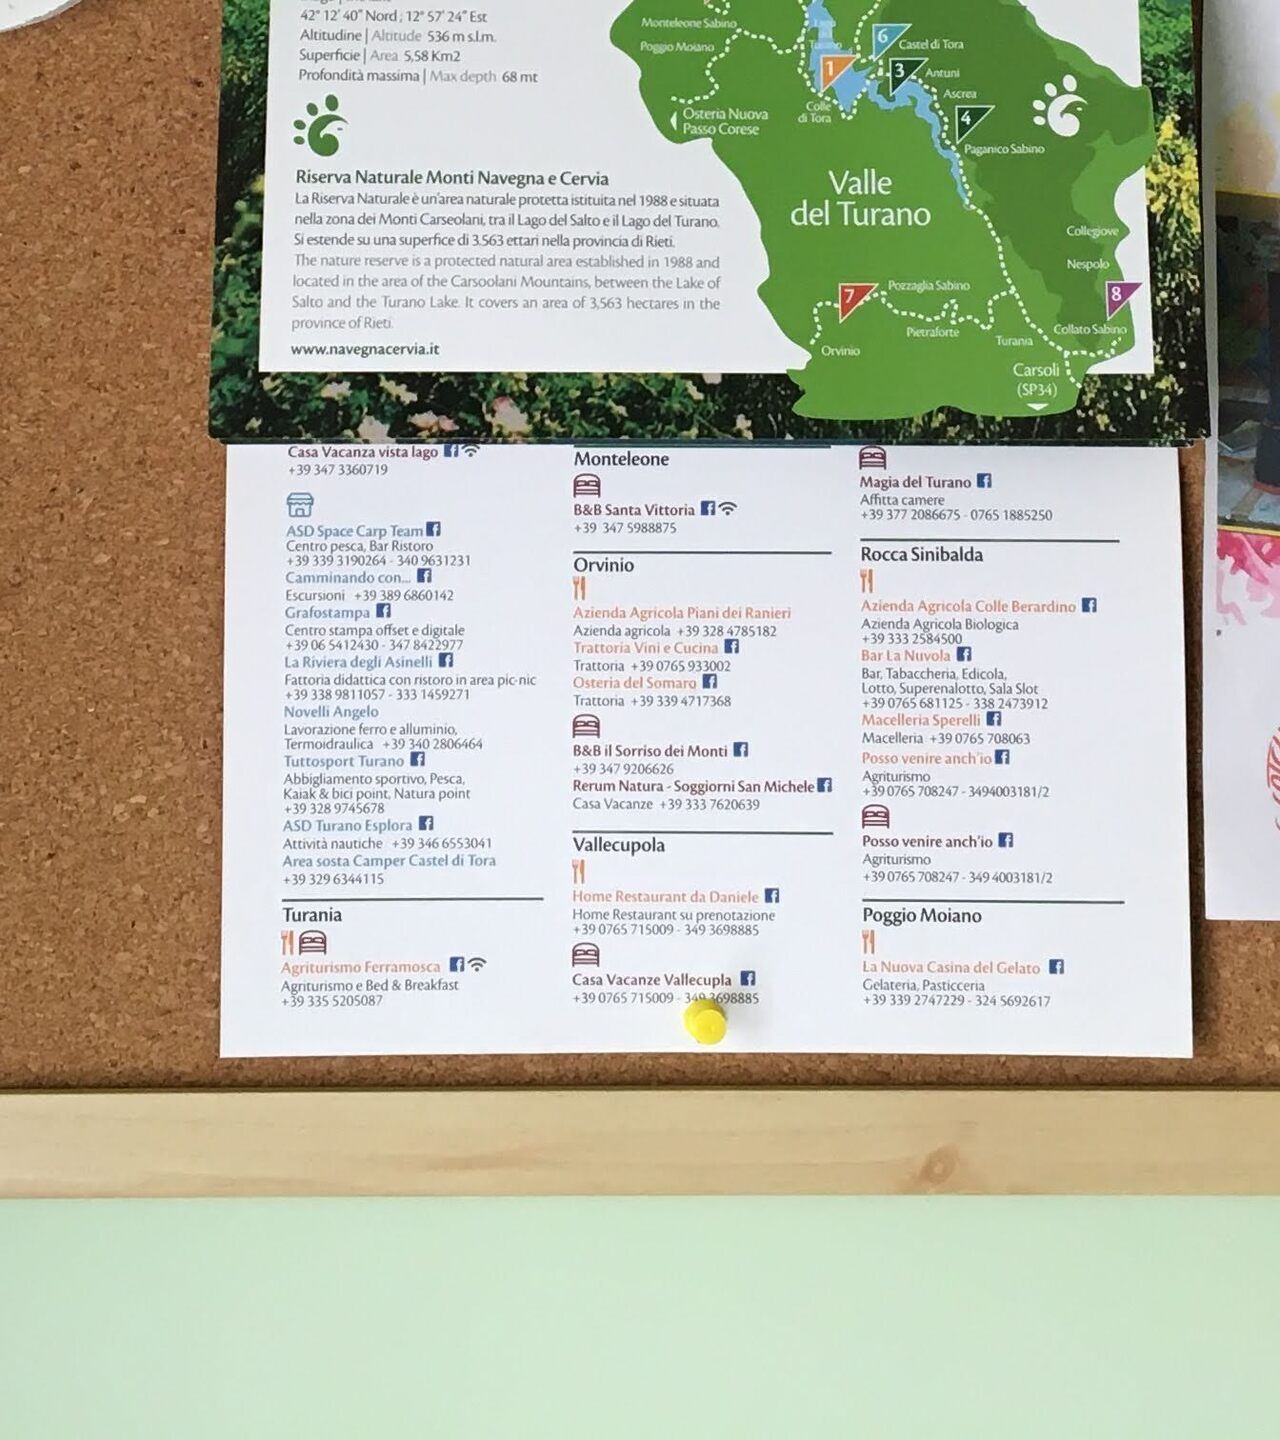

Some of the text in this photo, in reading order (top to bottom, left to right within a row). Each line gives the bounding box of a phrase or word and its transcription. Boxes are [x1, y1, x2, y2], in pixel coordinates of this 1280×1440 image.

[898, 37, 964, 49] Castel di Tora
[925, 66, 960, 80] Antuni
[683, 107, 768, 119] Osteria Nuova
[684, 123, 759, 135] Passo Corese
[963, 143, 1045, 156] Paganico Sabino
[297, 169, 609, 189] Riserva Naturale Monti Navegna e Cervia
[829, 169, 892, 195] Valle
[791, 201, 931, 226] del Turano
[1067, 258, 1110, 271] Nespolo
[291, 342, 439, 358] www.navegnacervia.it
[822, 345, 860, 356] Orvinio
[1013, 361, 1060, 376] Carsoli
[1017, 383, 1057, 398] (SP34)
[288, 446, 438, 461] Casa Vacanza vista lago
[574, 451, 669, 466] Monteleone
[860, 475, 971, 491] Magia del Turano
[574, 504, 695, 516] B&B Santa Vittoria
[575, 522, 677, 533] +39 347 5988875
[862, 546, 983, 562] Rocca Sinibalda
[574, 557, 634, 572] Orvinio
[862, 713, 980, 729] Macelleria Sperelli
[573, 837, 665, 856] Vallecupola
[283, 907, 342, 922] Turania
[864, 907, 982, 926] Poggio Moiano
